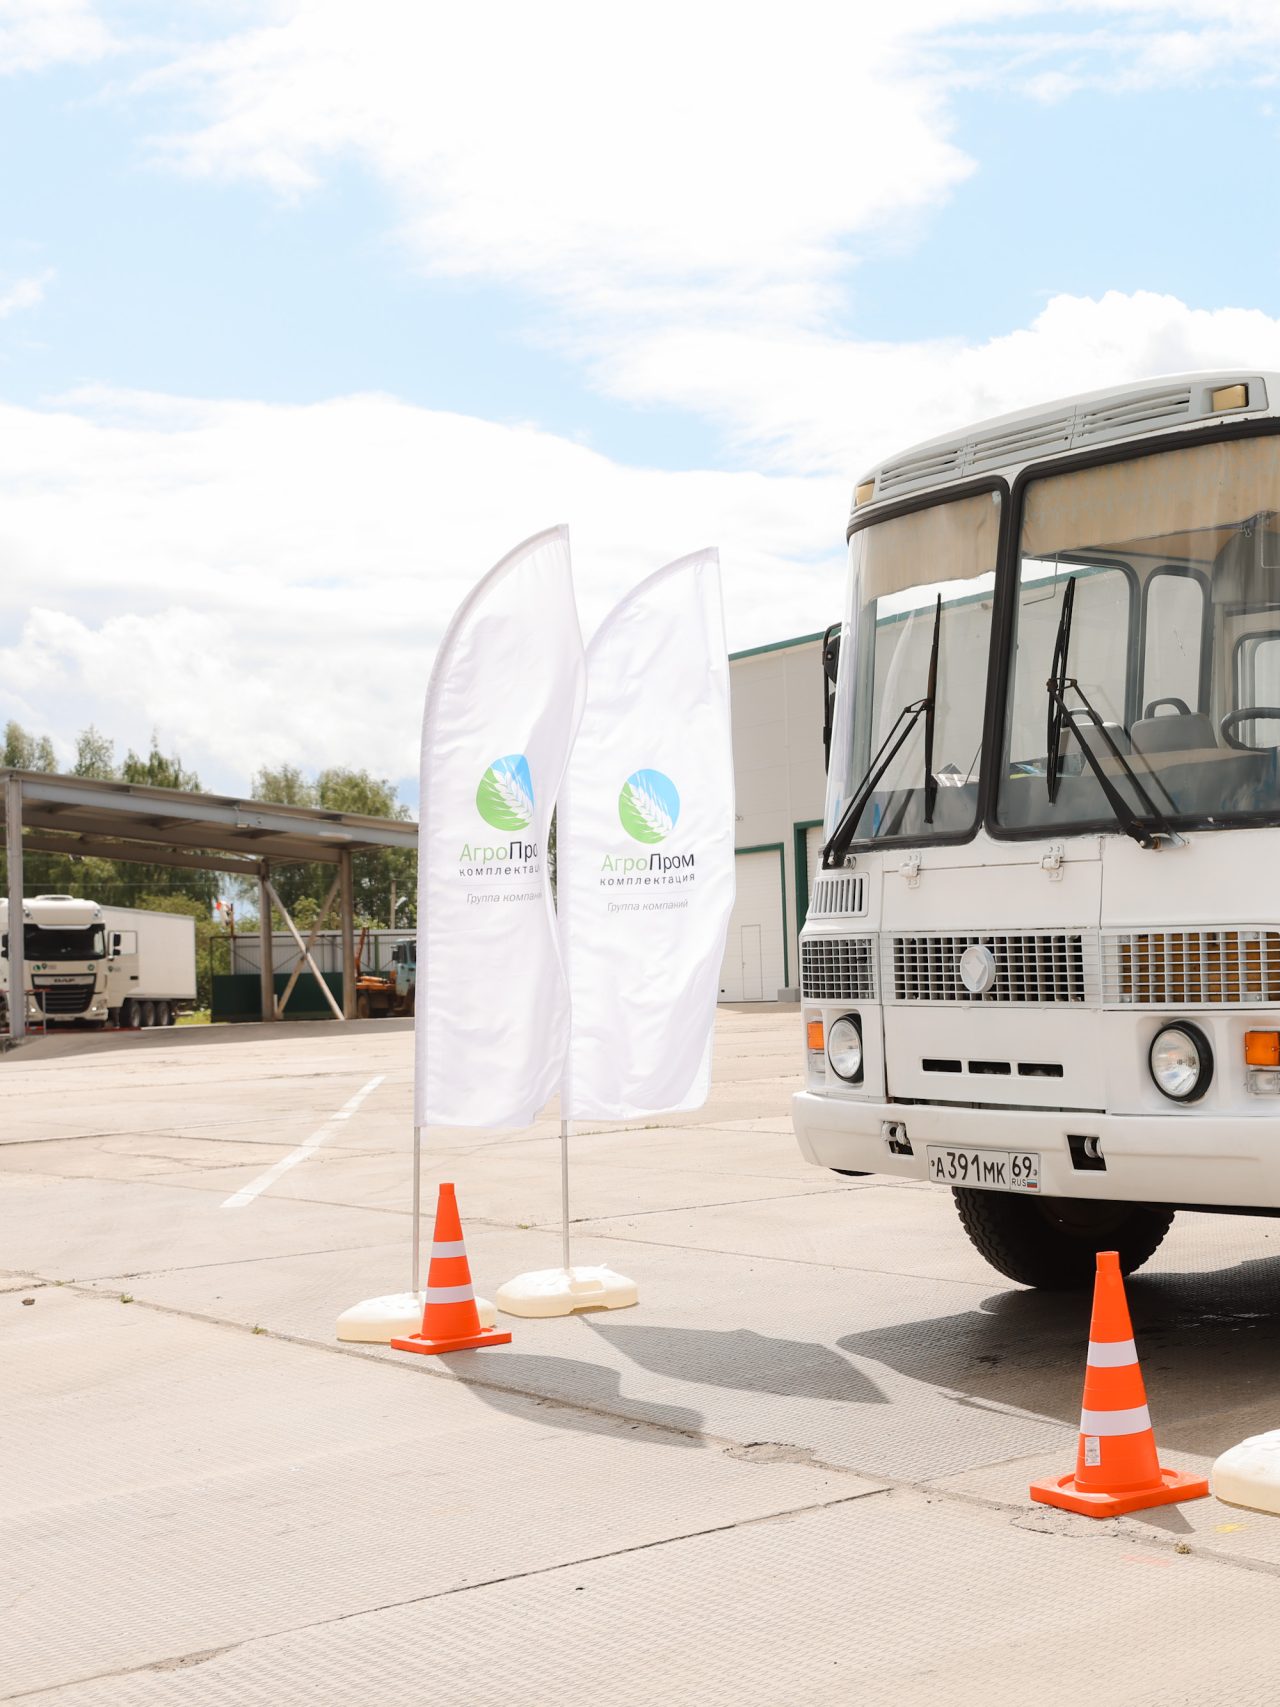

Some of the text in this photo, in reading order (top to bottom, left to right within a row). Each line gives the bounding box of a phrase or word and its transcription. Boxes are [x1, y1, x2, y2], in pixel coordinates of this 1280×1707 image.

[459, 841, 538, 865] АгроПро
[601, 853, 695, 875] АгроПром
[600, 873, 695, 886] комплектация
[466, 893, 500, 905] Группа
[607, 898, 689, 913] Группа компаний
[936, 1151, 1032, 1185] А391МК 69
[1011, 1178, 1027, 1188] RUS
